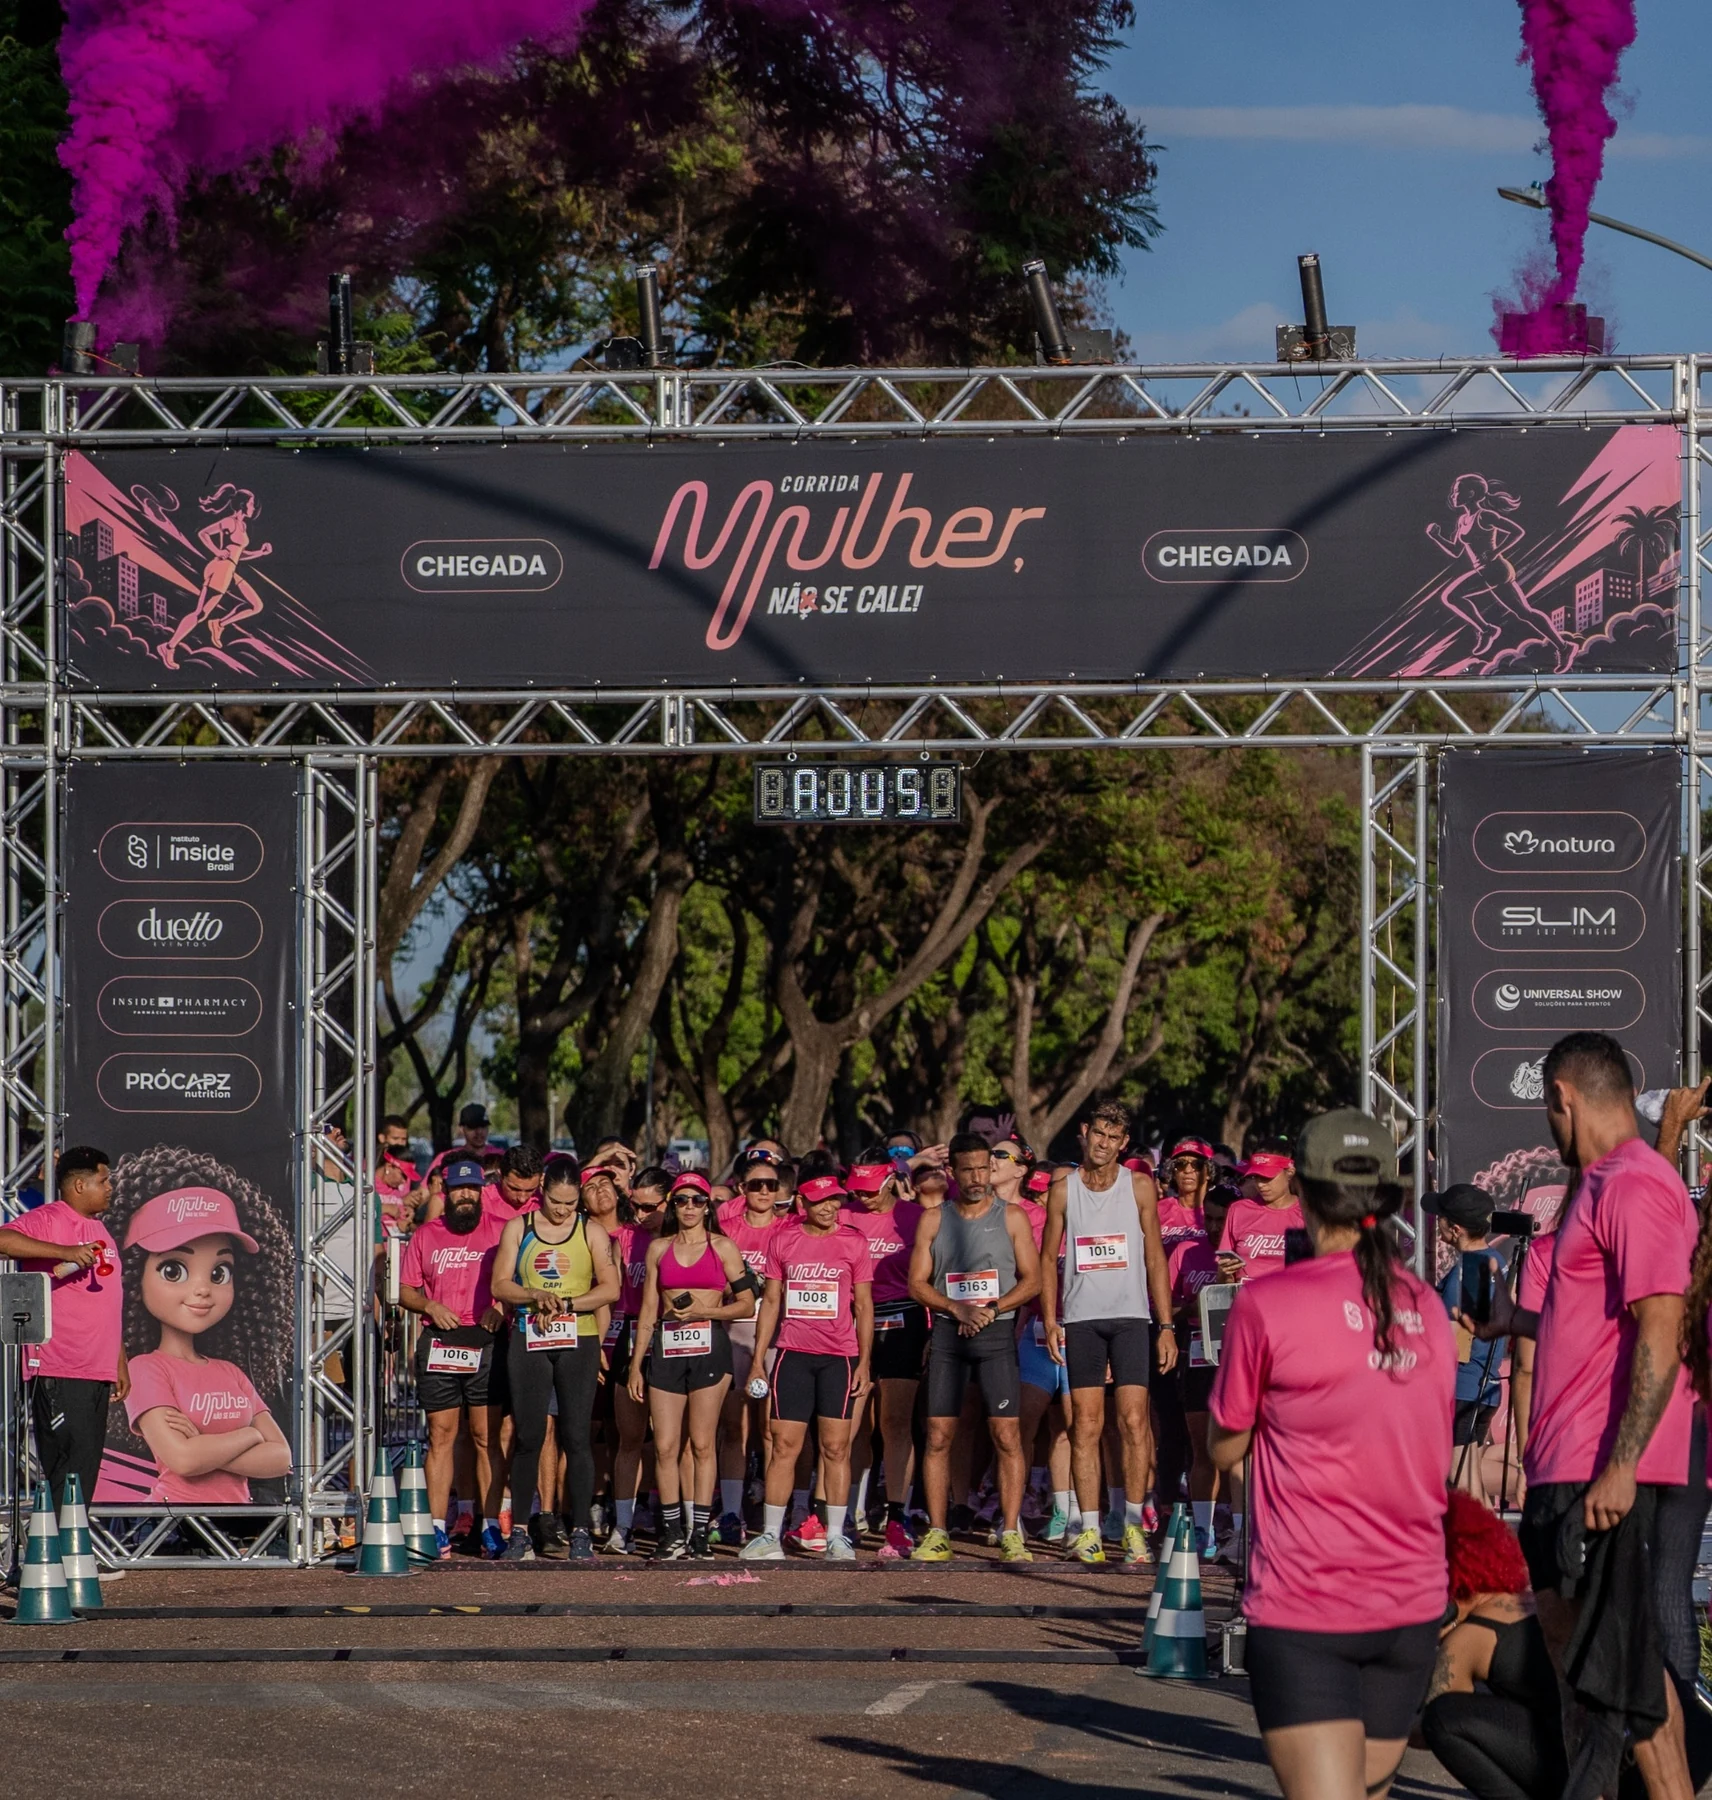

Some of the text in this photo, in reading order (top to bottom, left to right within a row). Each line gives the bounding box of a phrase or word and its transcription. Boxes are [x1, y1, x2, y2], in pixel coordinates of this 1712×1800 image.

[780, 475, 860, 493] CORRIDA
[1157, 543, 1292, 568] CHEGADA
[416, 552, 546, 579] CHEGADA
[767, 582, 924, 620] NÃO SE CALE!
[1541, 837, 1615, 853] natura
[170, 844, 235, 861] Inside
[207, 863, 234, 872] Brasil
[1502, 907, 1616, 926] SLIM
[137, 907, 223, 941] duetto
[1523, 989, 1622, 999] UNIVERSAL SHOW
[112, 998, 247, 1007] INSIDE PHARMACY
[126, 1068, 231, 1091] PRÓCAPZ
[184, 1090, 231, 1099] nutrition
[1089, 1245, 1116, 1257] 1015
[959, 1281, 988, 1292] 5163
[798, 1291, 828, 1303] 1008
[546, 1322, 566, 1333] 031
[673, 1330, 700, 1341] 5120
[443, 1349, 469, 1361] 1016
